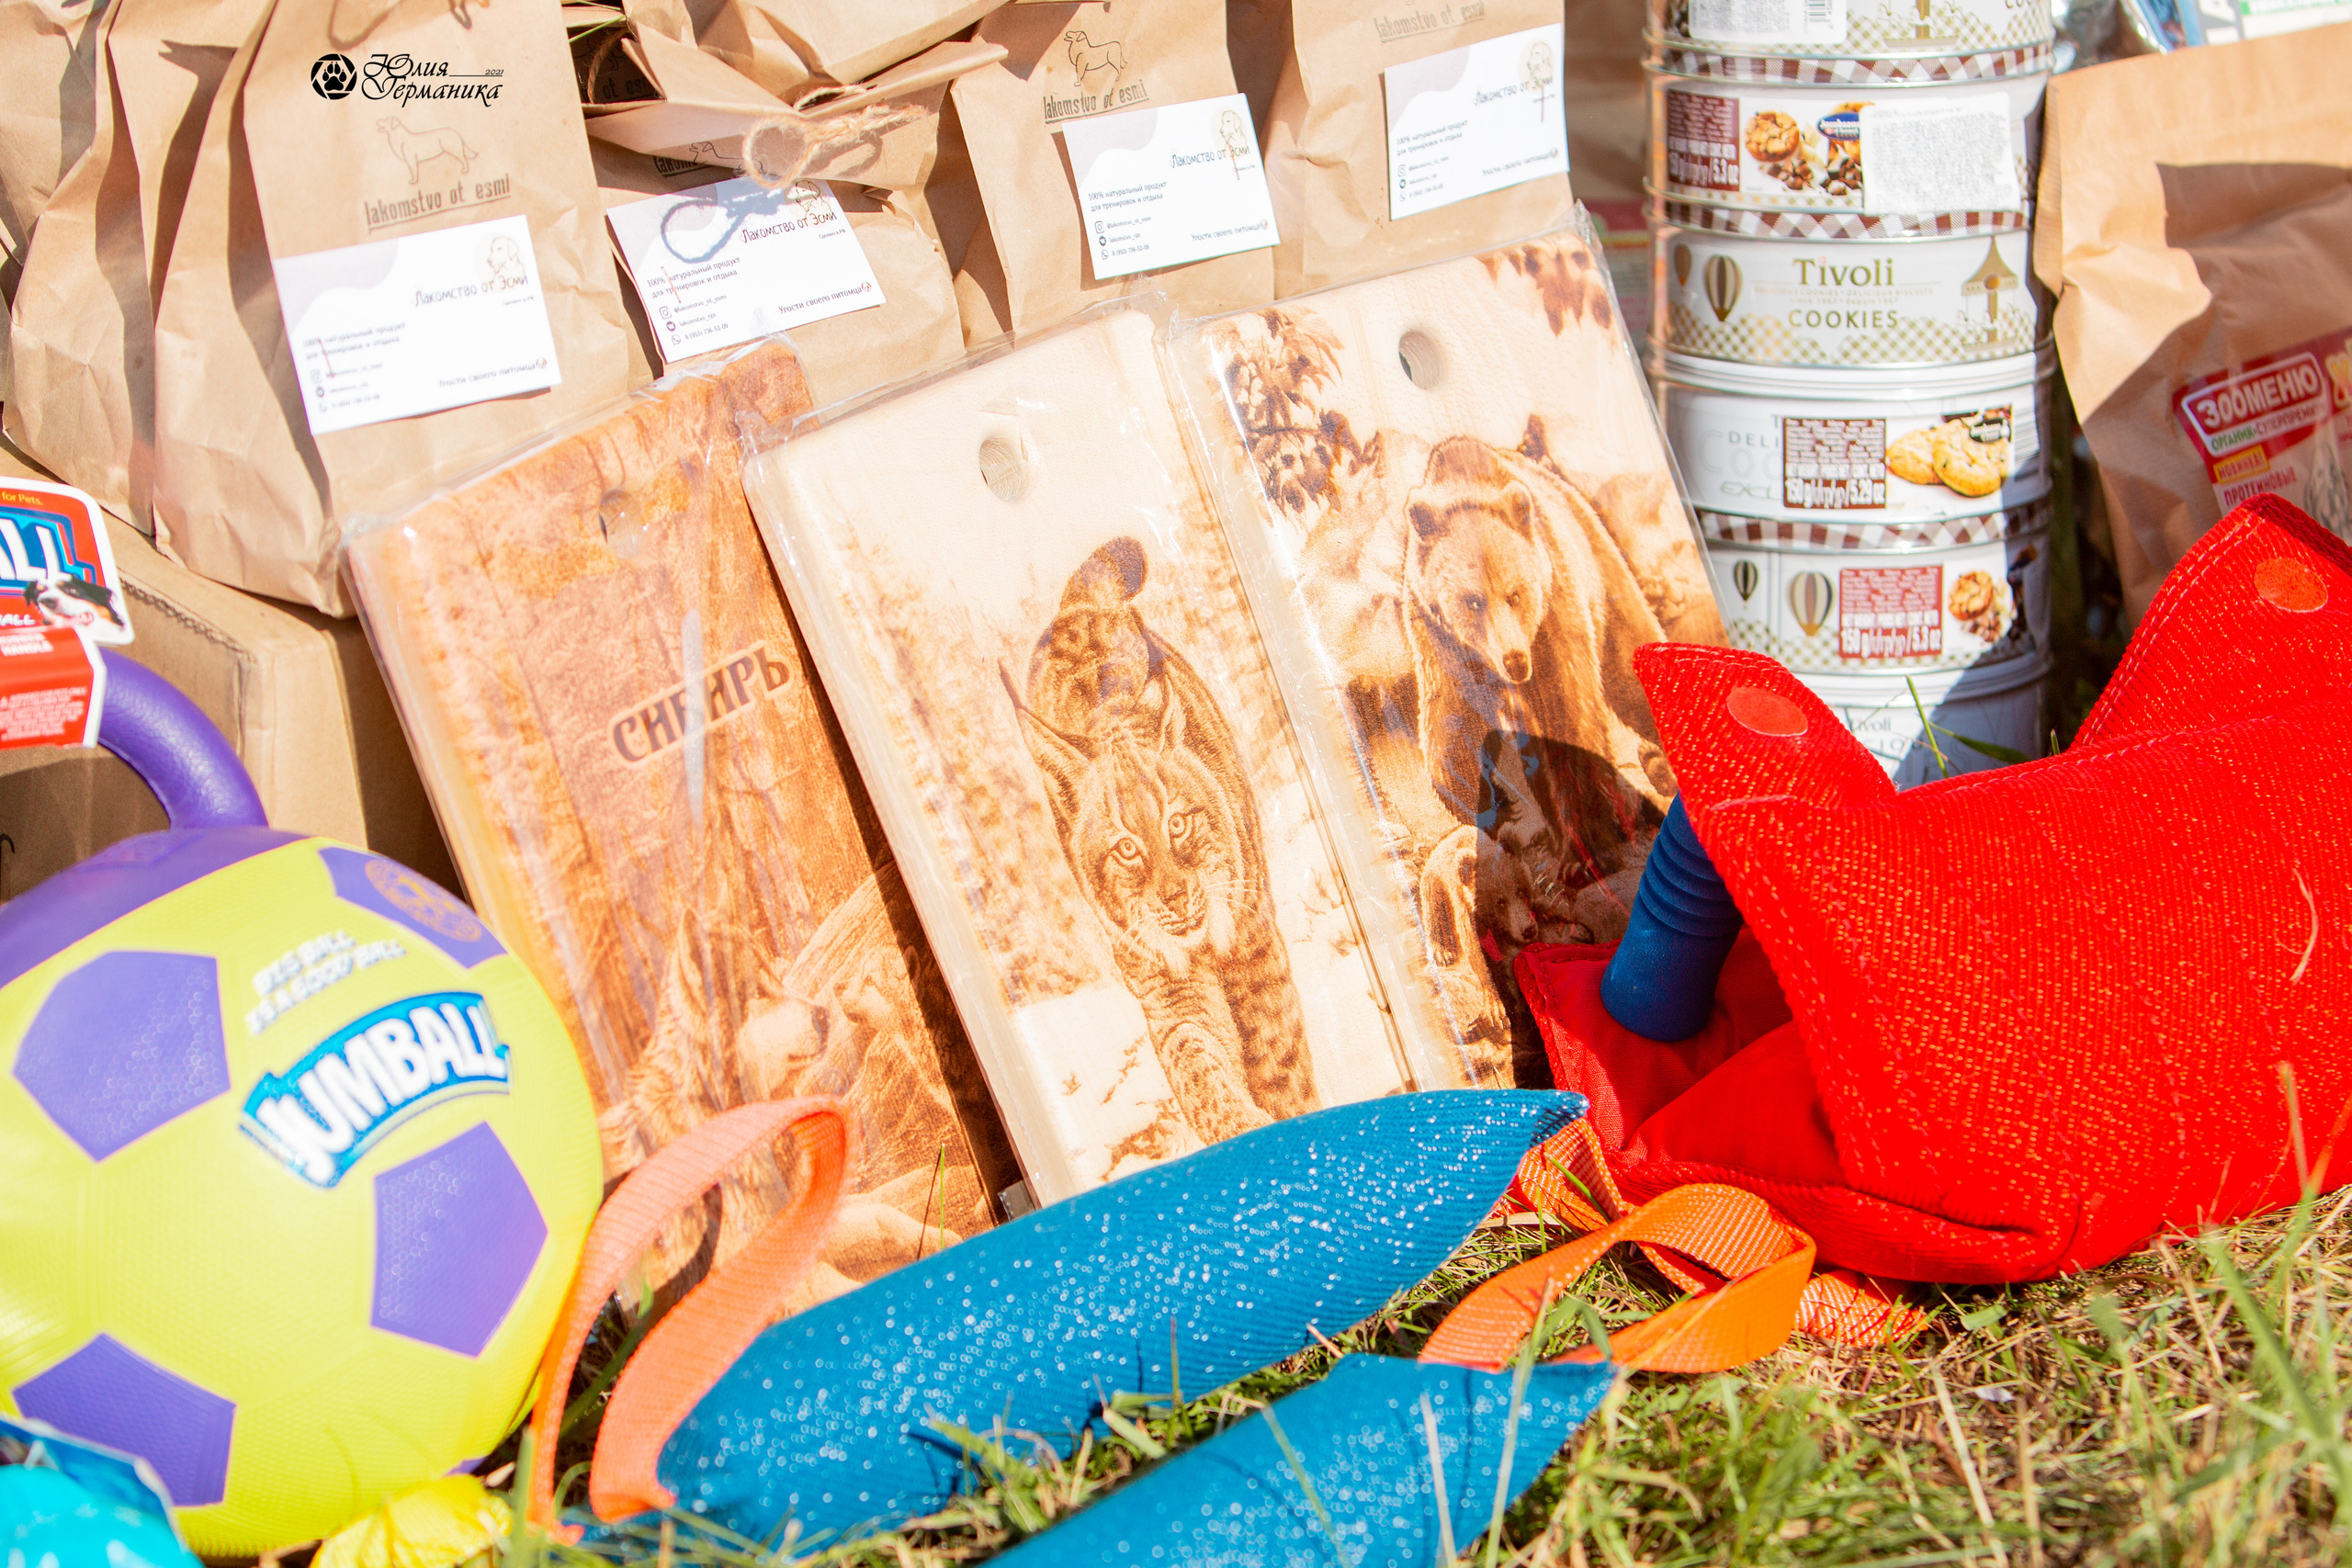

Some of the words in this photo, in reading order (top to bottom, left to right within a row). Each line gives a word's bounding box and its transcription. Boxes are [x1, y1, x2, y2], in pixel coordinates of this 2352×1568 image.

[1374, 10, 1438, 39] lakomstvo
[1441, 4, 1455, 25] ot
[1043, 92, 1097, 119] lakomstvo
[1102, 88, 1114, 108] ot
[1119, 80, 1148, 103] esmi
[1474, 84, 1517, 106] Лакомство
[1520, 80, 1530, 92] от
[1532, 75, 1554, 90] Эсми
[1171, 151, 1216, 168] Лакомство
[1217, 148, 1227, 160] от
[1228, 144, 1250, 158] Эсми
[365, 189, 442, 225] lakomstvo
[449, 180, 466, 204] ot
[475, 173, 510, 200] esmi
[1088, 190, 1104, 201] 100%
[1105, 185, 1143, 197] натуральный
[1144, 181, 1167, 192] продукт
[1091, 204, 1102, 212] для
[1102, 198, 1136, 211] тренировок
[1142, 193, 1163, 202] отдыха
[741, 220, 796, 243] Лакомство
[797, 217, 808, 229] от
[809, 211, 838, 226] Эсми
[1213, 229, 1233, 239] своего
[1234, 223, 1261, 234] питомца
[647, 276, 666, 288] 100%
[713, 257, 741, 270] продукт
[652, 289, 664, 299] для
[665, 278, 706, 295] тренировок
[713, 269, 738, 282] отдыха
[1793, 256, 1894, 286] Tivoli
[414, 281, 477, 307] Лакомство
[481, 280, 494, 293] от
[500, 274, 528, 291] Эсми
[806, 295, 831, 307] своего
[831, 286, 863, 299] питомца
[1789, 309, 1898, 328] COOKIES
[469, 369, 497, 382] своего
[499, 362, 536, 377] питомца
[2197, 364, 2320, 429] ЗООМЕНЮ
[2, 491, 17, 502] for
[18, 493, 43, 505] Pets.
